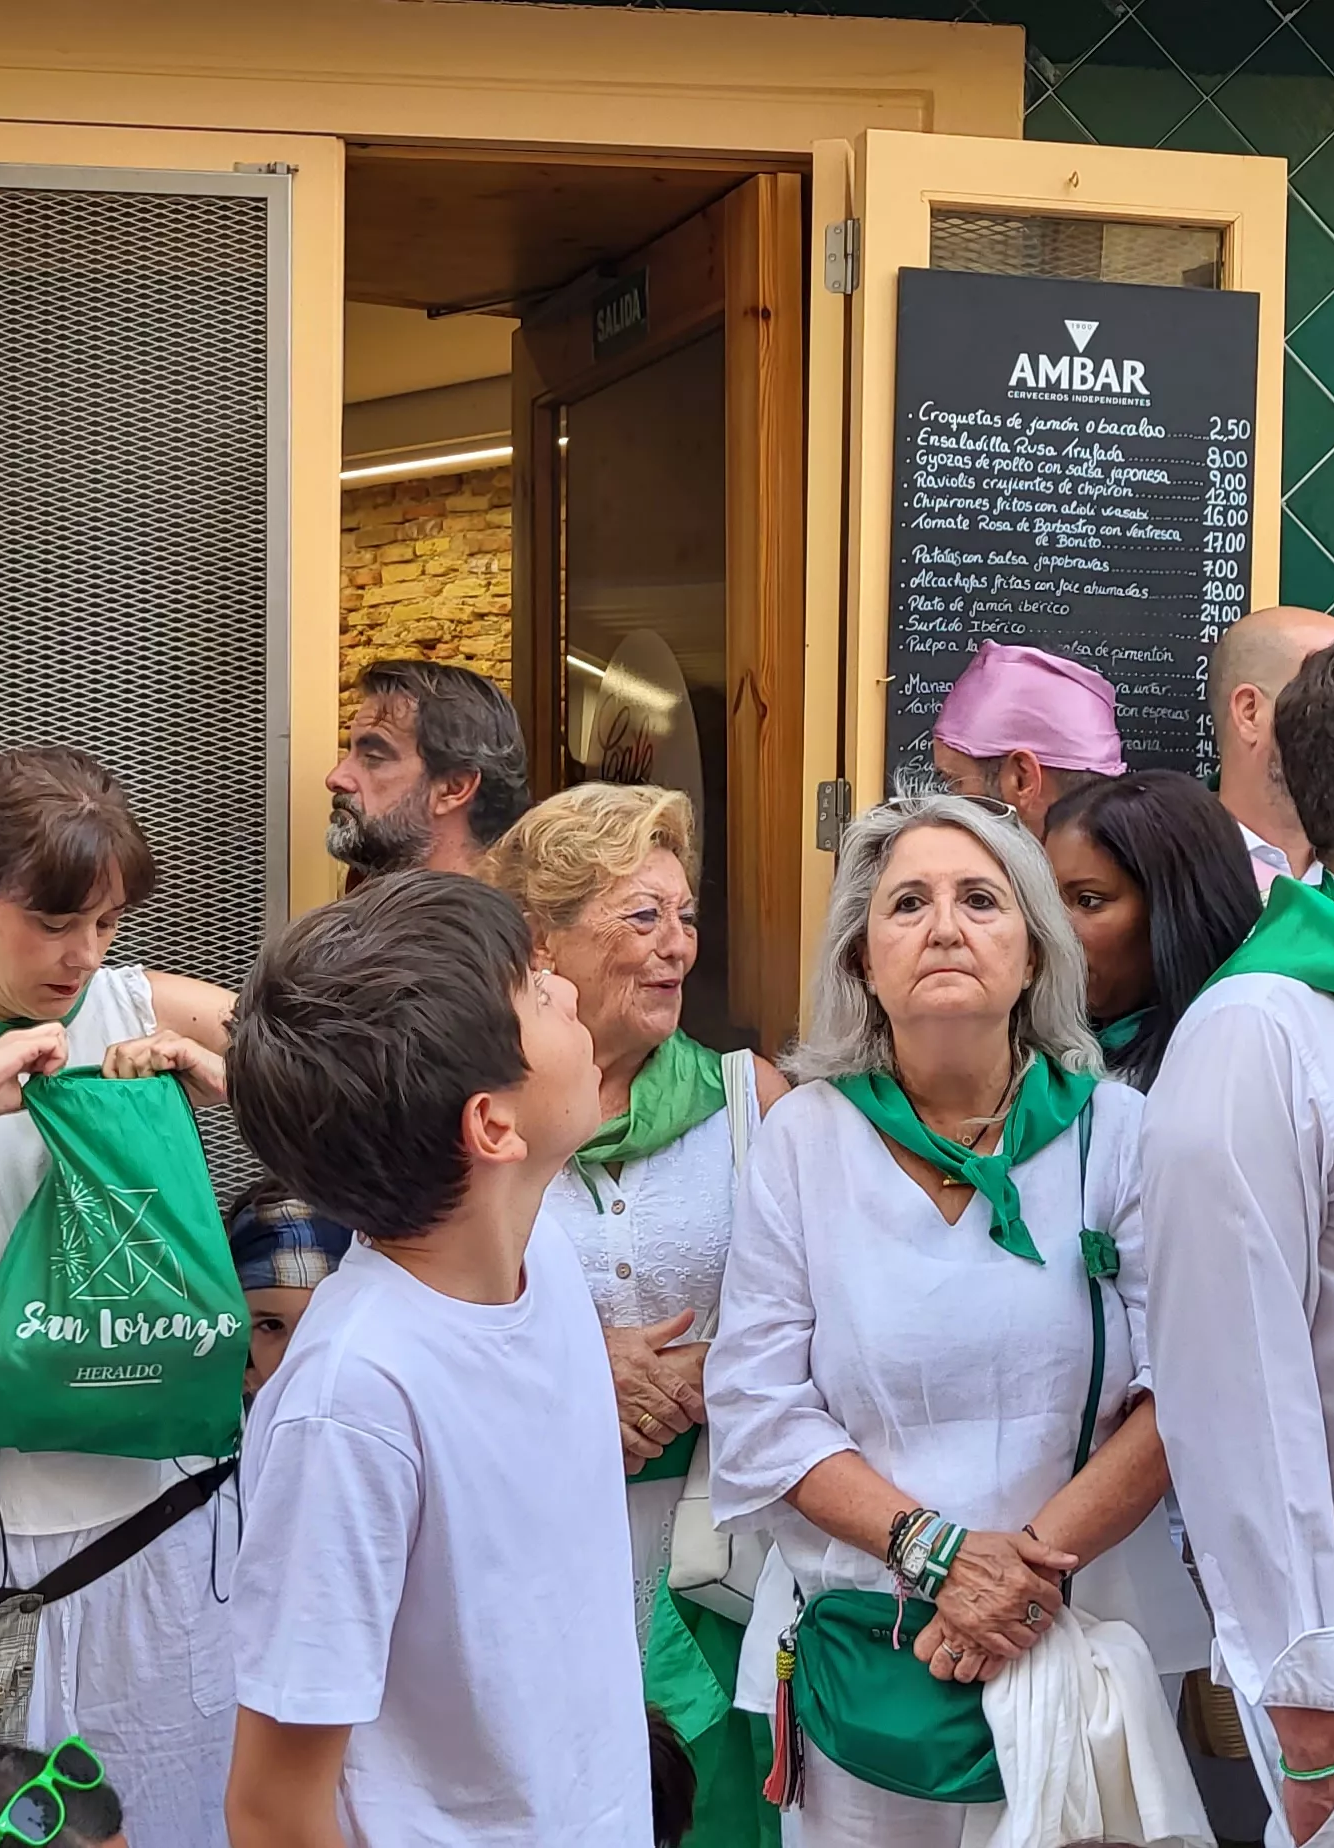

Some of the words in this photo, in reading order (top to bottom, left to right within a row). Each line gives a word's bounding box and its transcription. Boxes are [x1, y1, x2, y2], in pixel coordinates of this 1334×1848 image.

[596, 287, 641, 343] SALIDA
[1008, 352, 1151, 395] AMBAR
[1007, 390, 1069, 402] CERVECEROS
[1072, 394, 1151, 407] INDEPENDIENTES
[919, 401, 1002, 431] Croquetas
[1006, 412, 1022, 429] de
[1026, 416, 1079, 435] jamón
[1097, 417, 1166, 438] bacalao
[1209, 416, 1251, 442] 2,50
[917, 427, 1011, 453] Ensaladilla
[1014, 437, 1057, 456] Rusa
[1206, 446, 1248, 468] 8.00
[916, 449, 972, 472] Gyozas
[975, 454, 990, 469] de
[992, 457, 1034, 474] pollo
[1037, 461, 1062, 474] con
[1065, 462, 1104, 478] salsa
[1106, 466, 1170, 486] japonesa
[1209, 470, 1247, 490] 9.00
[913, 470, 976, 489] Raviolis
[982, 475, 1054, 496] crujientes
[1058, 478, 1073, 494] de
[1205, 487, 1248, 506] 12.00
[911, 512, 970, 530] Tomate
[977, 515, 1014, 531] Rosa
[1016, 517, 1030, 532] de
[1032, 517, 1097, 534] Barbastro
[1099, 522, 1122, 536] con
[913, 492, 990, 512] Chipirones
[993, 496, 1032, 515] fritos
[1034, 501, 1058, 513] con
[1060, 501, 1097, 516] alioli
[1101, 506, 1150, 520] wasabi
[1202, 505, 1249, 527] 16.00
[1035, 533, 1049, 546] de
[1055, 534, 1102, 549] Bonito
[1203, 532, 1246, 553] 17.00
[912, 544, 961, 566] Patatas
[962, 552, 983, 564] con
[1033, 552, 1110, 573] japobravas
[1202, 559, 1238, 579] 7.00
[910, 568, 987, 593] Alcachofas
[991, 573, 1031, 594] fritas
[1034, 581, 1055, 591] con
[1056, 578, 1079, 597] foie
[1082, 580, 1149, 599] ahumadas
[1202, 580, 1245, 601] 18.00
[905, 614, 963, 632] Surtido
[967, 617, 1026, 634] Ibérico
[907, 594, 945, 611] Plato
[949, 596, 964, 612] de
[969, 598, 1013, 617] jamón
[1200, 603, 1241, 623] 24.00
[906, 634, 945, 656] Pulpo
[948, 643, 960, 652] a
[965, 638, 979, 653] la
[1095, 640, 1109, 657] de
[1111, 644, 1174, 666] pimentón
[16, 1300, 89, 1345] San
[99, 1307, 242, 1357] Lorenzo
[75, 1363, 163, 1382] HERALDO
